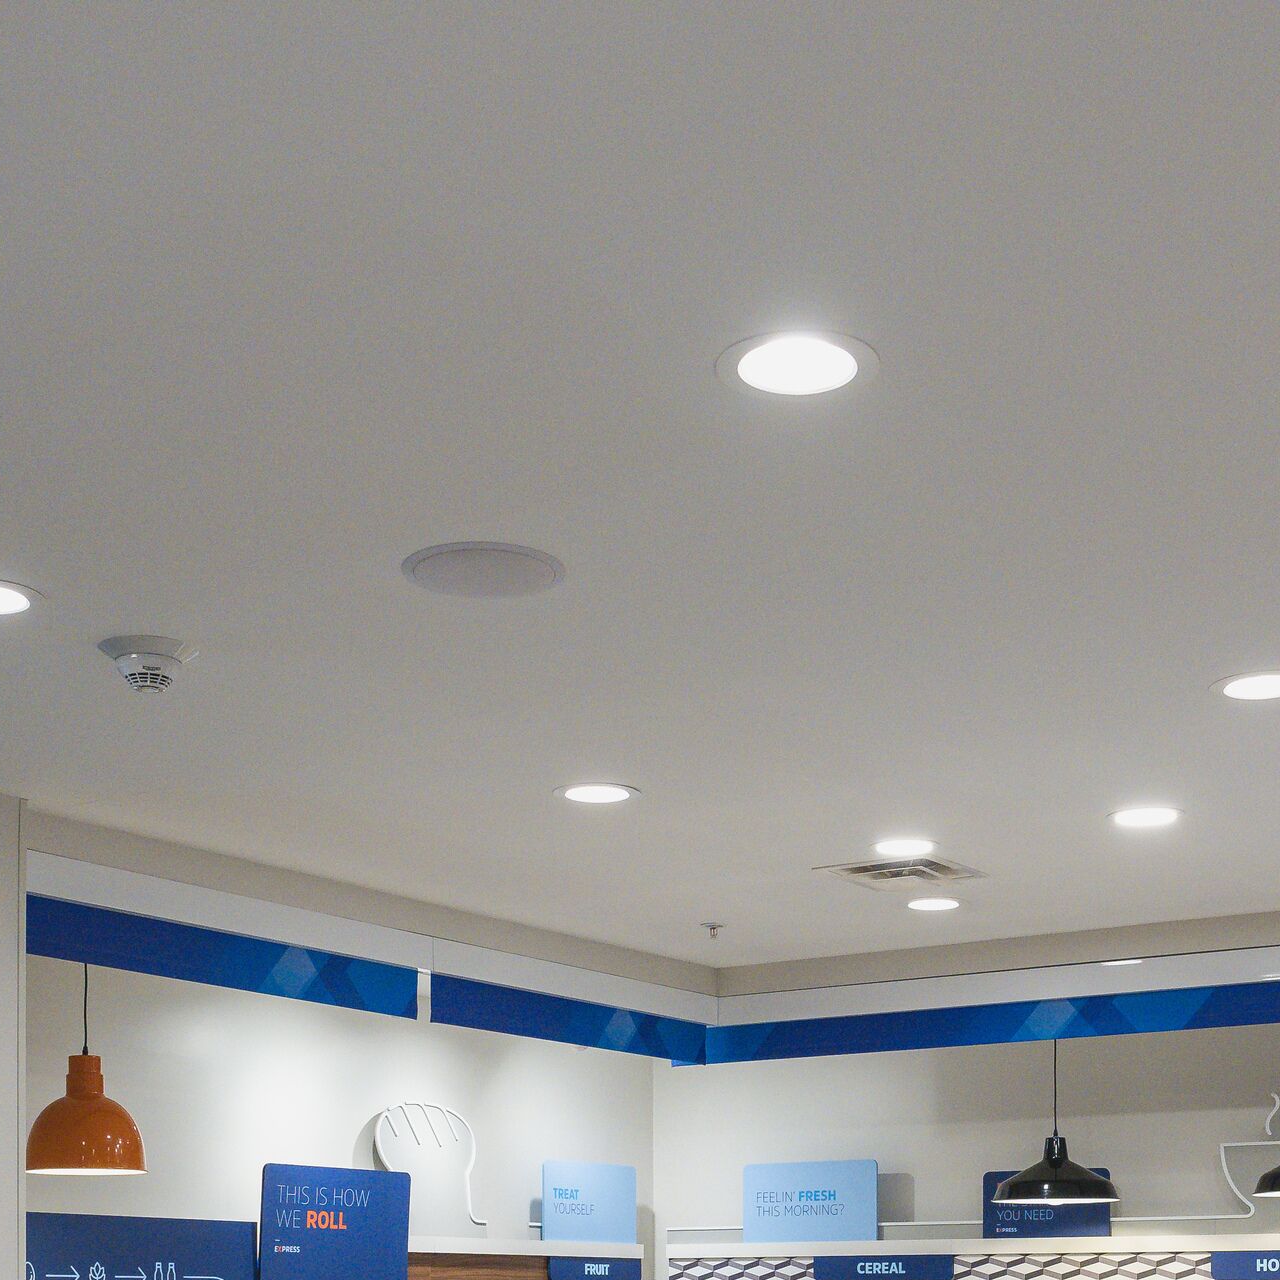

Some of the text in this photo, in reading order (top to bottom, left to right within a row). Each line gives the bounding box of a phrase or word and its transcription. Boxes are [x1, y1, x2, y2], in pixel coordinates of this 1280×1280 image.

[277, 1184, 370, 1207] THIS IS HOW
[552, 1187, 580, 1201] TREAT
[799, 1190, 837, 1202] FRESH
[553, 1202, 595, 1216] YOURSELF
[756, 1203, 845, 1217] THIS MORNING?
[997, 1208, 1055, 1221] YOU NEED
[276, 1209, 347, 1230] WE ROLL
[274, 1245, 300, 1253] EXPRESS
[584, 1263, 610, 1276] FRUIT
[856, 1261, 906, 1275] CEREAL
